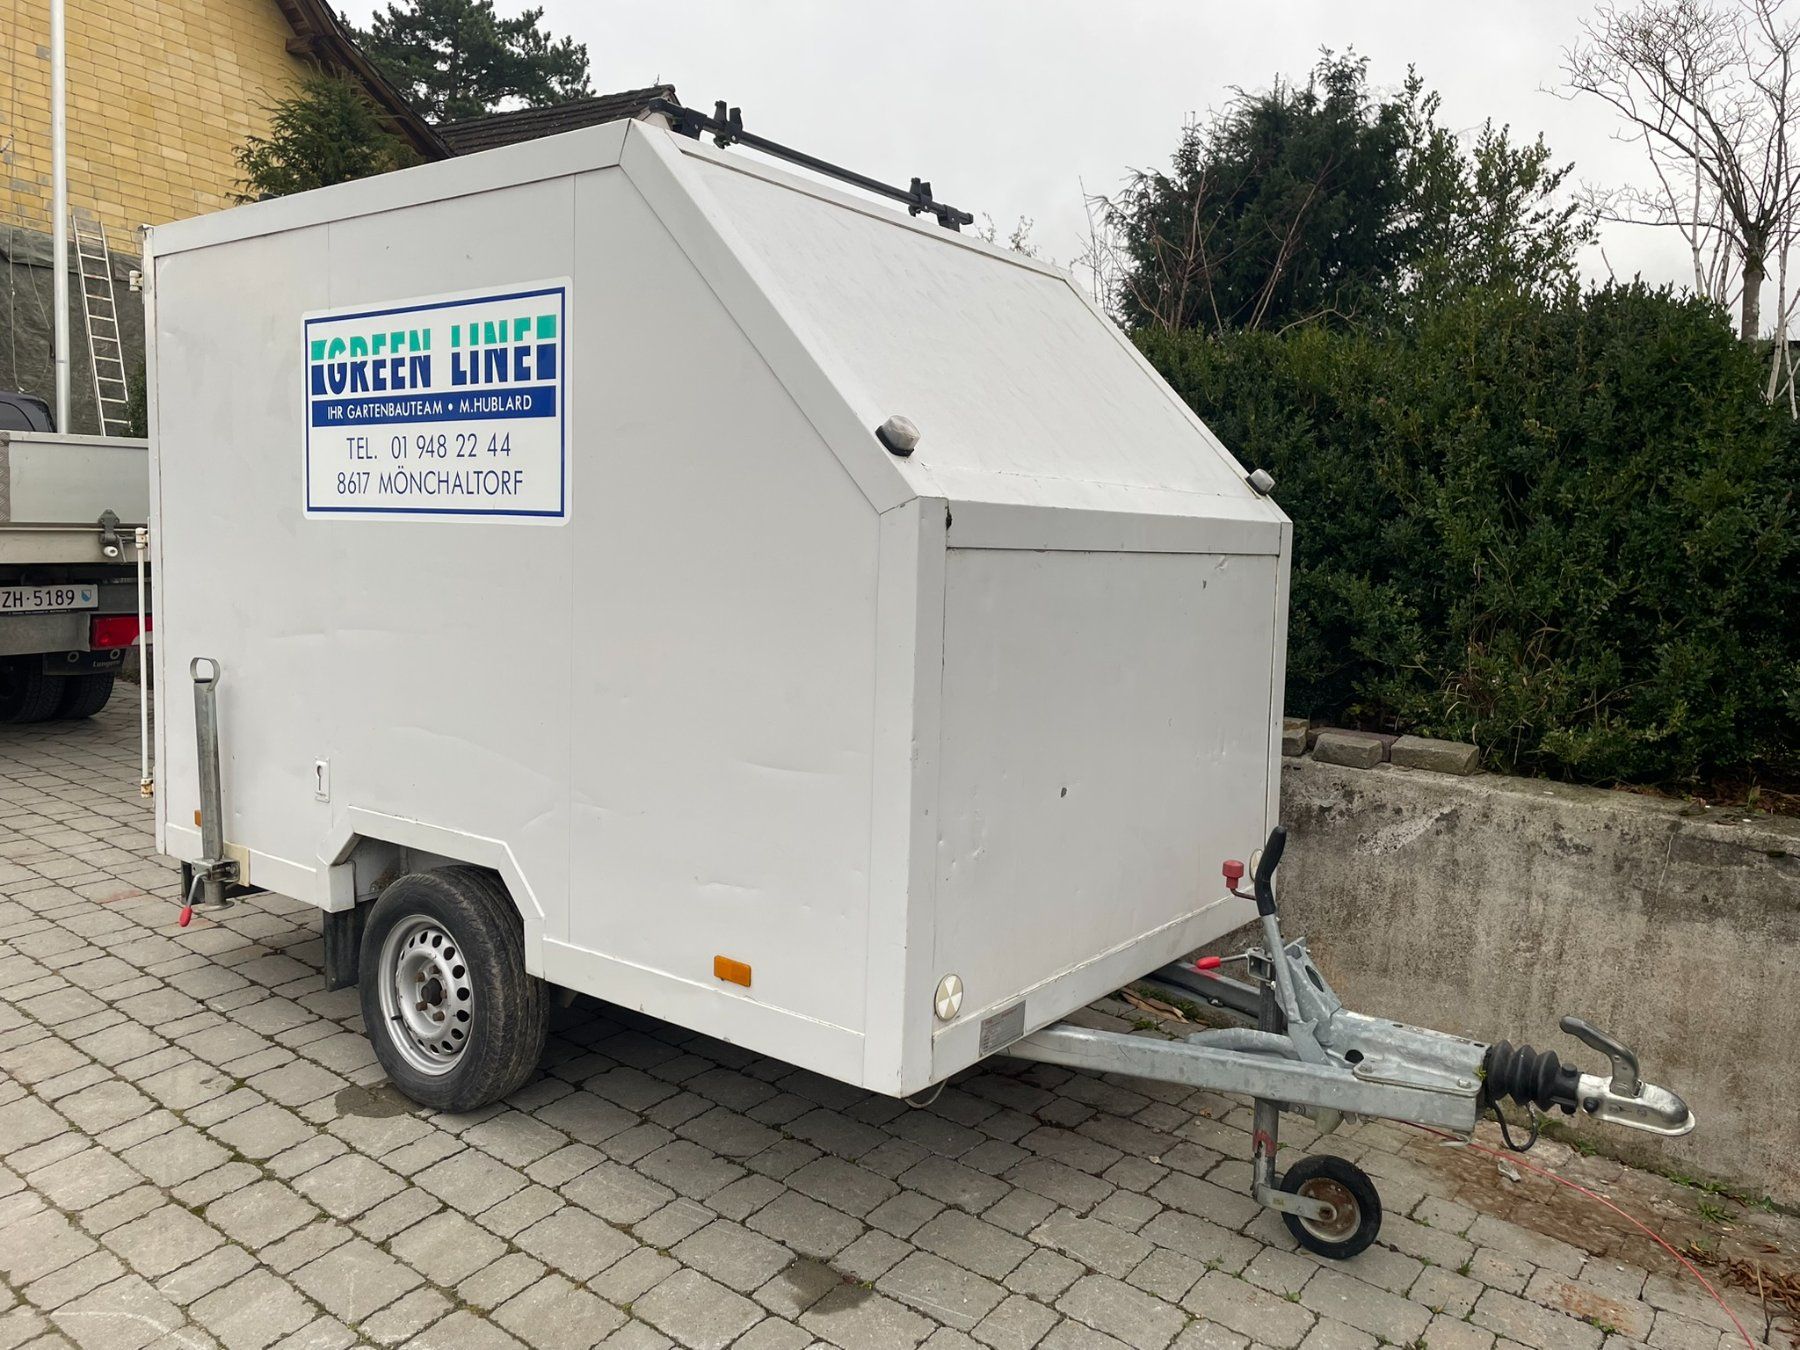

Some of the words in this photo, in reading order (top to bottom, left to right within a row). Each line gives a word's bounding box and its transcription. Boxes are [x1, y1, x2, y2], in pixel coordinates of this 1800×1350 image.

[328, 328, 431, 395] GREEN
[451, 317, 531, 386] LINE
[327, 405, 343, 420] IHR
[347, 400, 443, 419] GARTENBAUTEAM
[460, 395, 533, 413] M.HUBLARD
[346, 437, 378, 460] TEL.
[391, 436, 408, 459] 01
[416, 434, 447, 459] 948
[456, 433, 477, 458] 22
[487, 431, 511, 457] 44
[337, 471, 370, 495] 8617
[378, 465, 523, 496] MÖNCHALTORF
